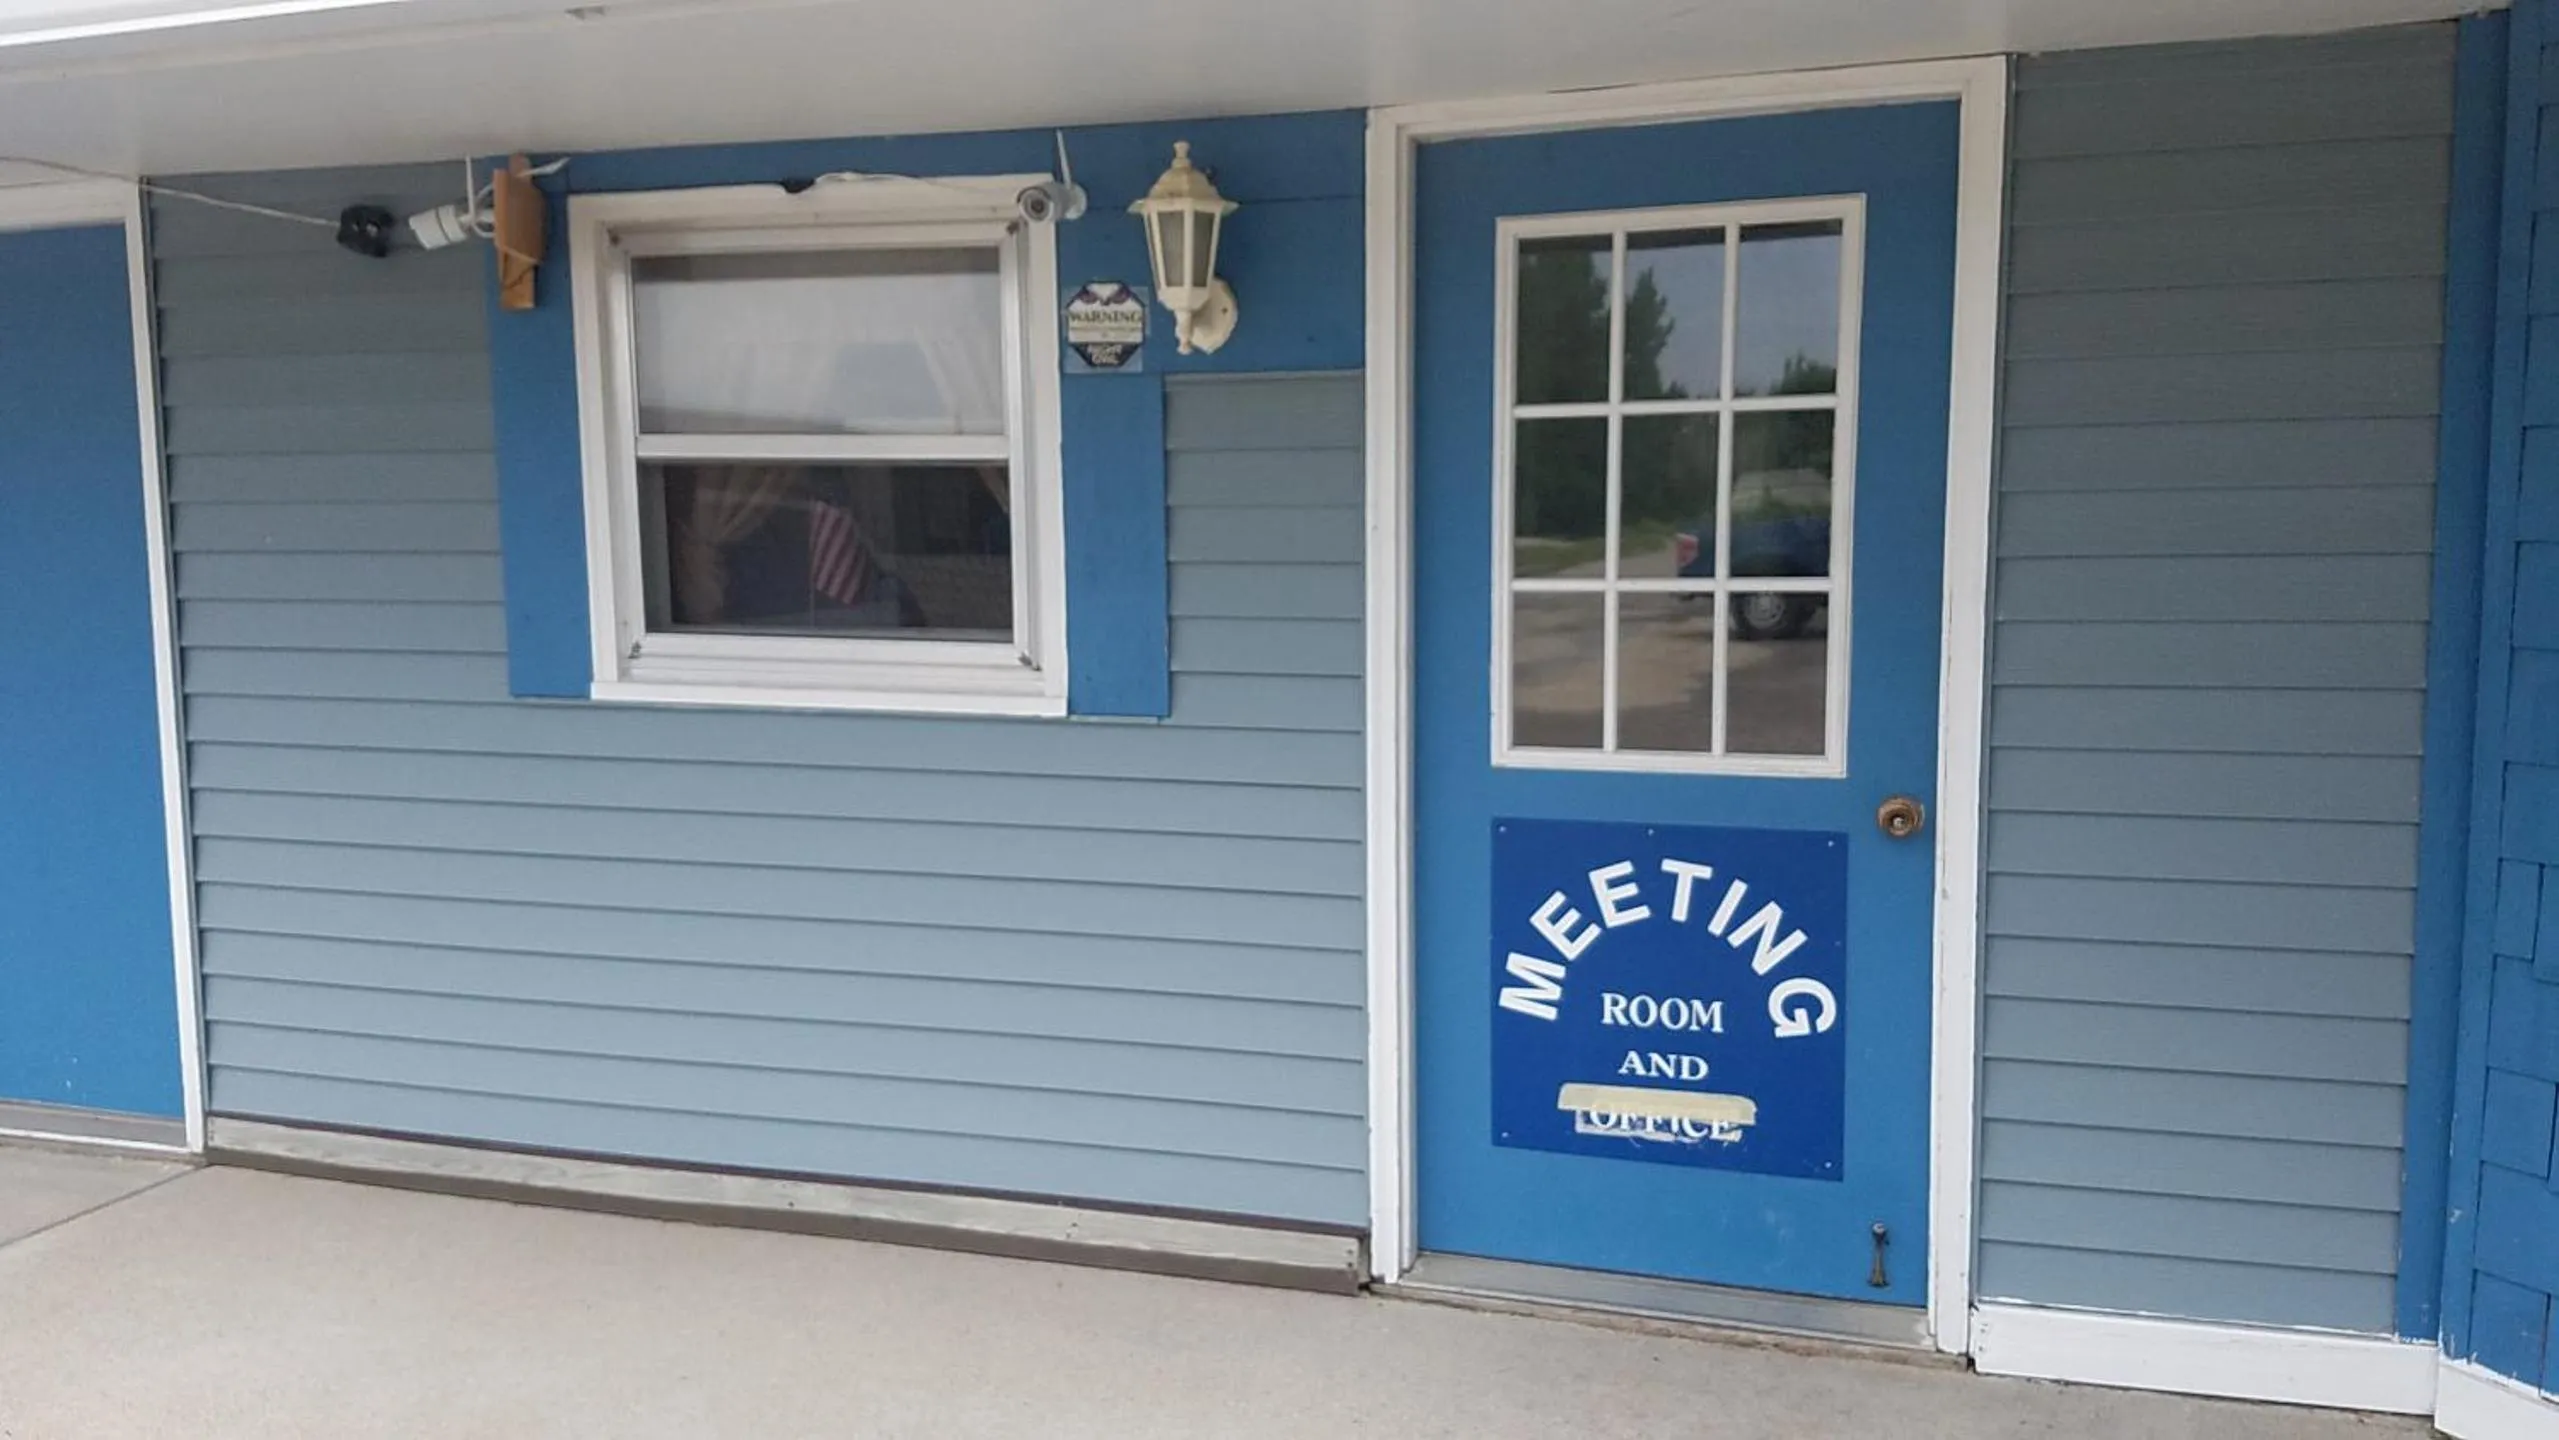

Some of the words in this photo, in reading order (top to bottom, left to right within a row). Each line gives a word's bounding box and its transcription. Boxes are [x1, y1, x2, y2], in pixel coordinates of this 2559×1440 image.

[1068, 309, 1142, 323] WARNING
[1499, 858, 1837, 1038] MEETING
[1601, 992, 1724, 1033] ROOM
[1618, 1050, 1709, 1081] AND
